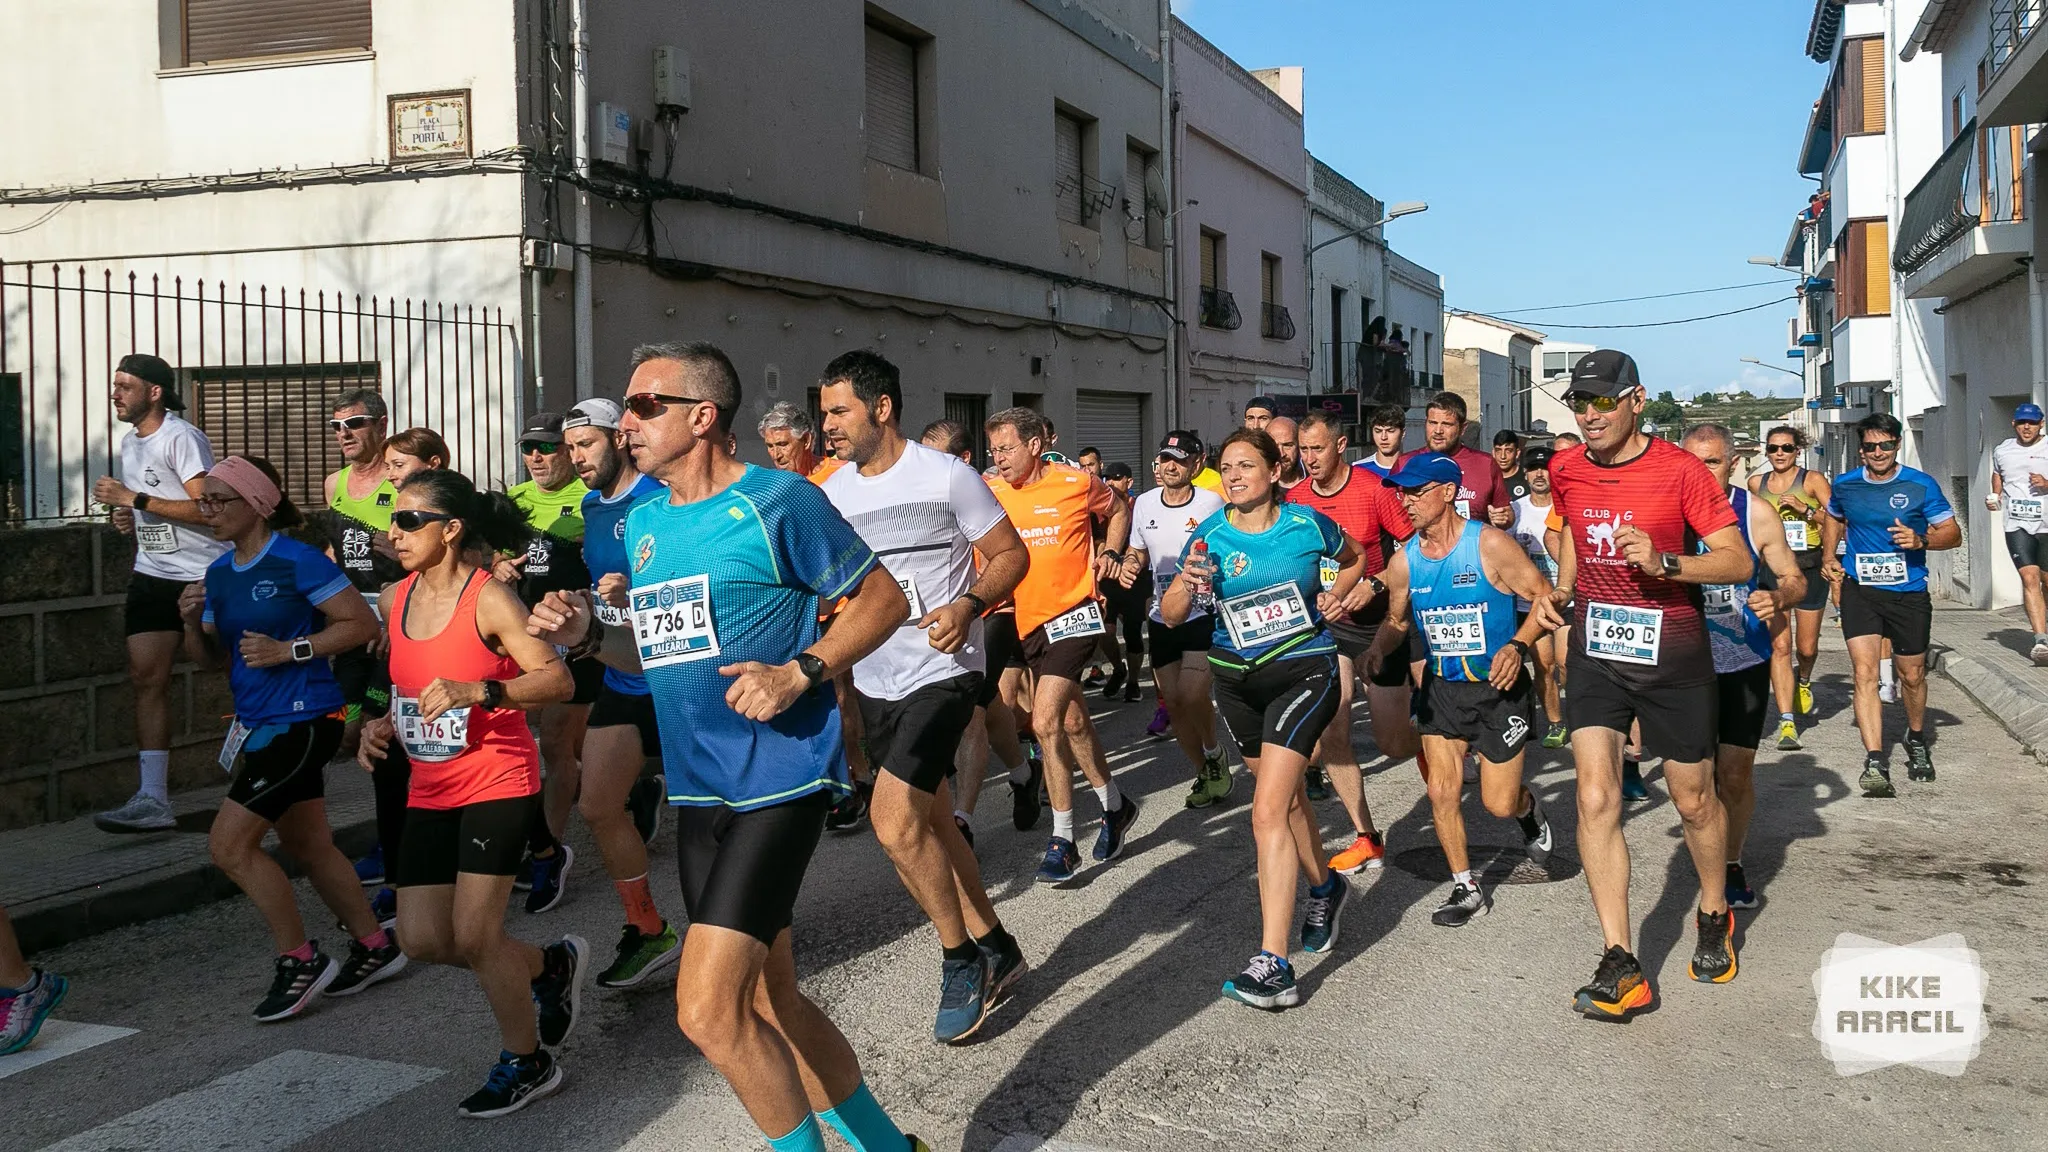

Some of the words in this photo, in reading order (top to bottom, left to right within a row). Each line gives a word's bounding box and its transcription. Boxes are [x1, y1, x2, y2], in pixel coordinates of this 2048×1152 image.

[419, 117, 440, 125] PLAÇA
[412, 131, 448, 143] PORTAL
[1456, 485, 1476, 500] Blue
[1583, 508, 1611, 518] CLUB
[2020, 504, 2033, 513] 514
[1031, 536, 1059, 547] HOTEL
[1872, 565, 1891, 574] 675
[1452, 571, 1477, 585] cab
[601, 609, 617, 623] 466
[653, 611, 684, 635] 736
[693, 606, 704, 625] D
[1062, 612, 1085, 627] 750
[1255, 604, 1284, 623] 123
[1256, 622, 1292, 637] BALEARIA
[1441, 627, 1464, 639] 945
[1605, 625, 1635, 641] 690
[1644, 629, 1655, 643] D
[651, 639, 691, 656] BALEARIA
[1599, 643, 1636, 655] BALEARIA
[420, 722, 444, 739] 176
[417, 744, 450, 753] BALEARIA
